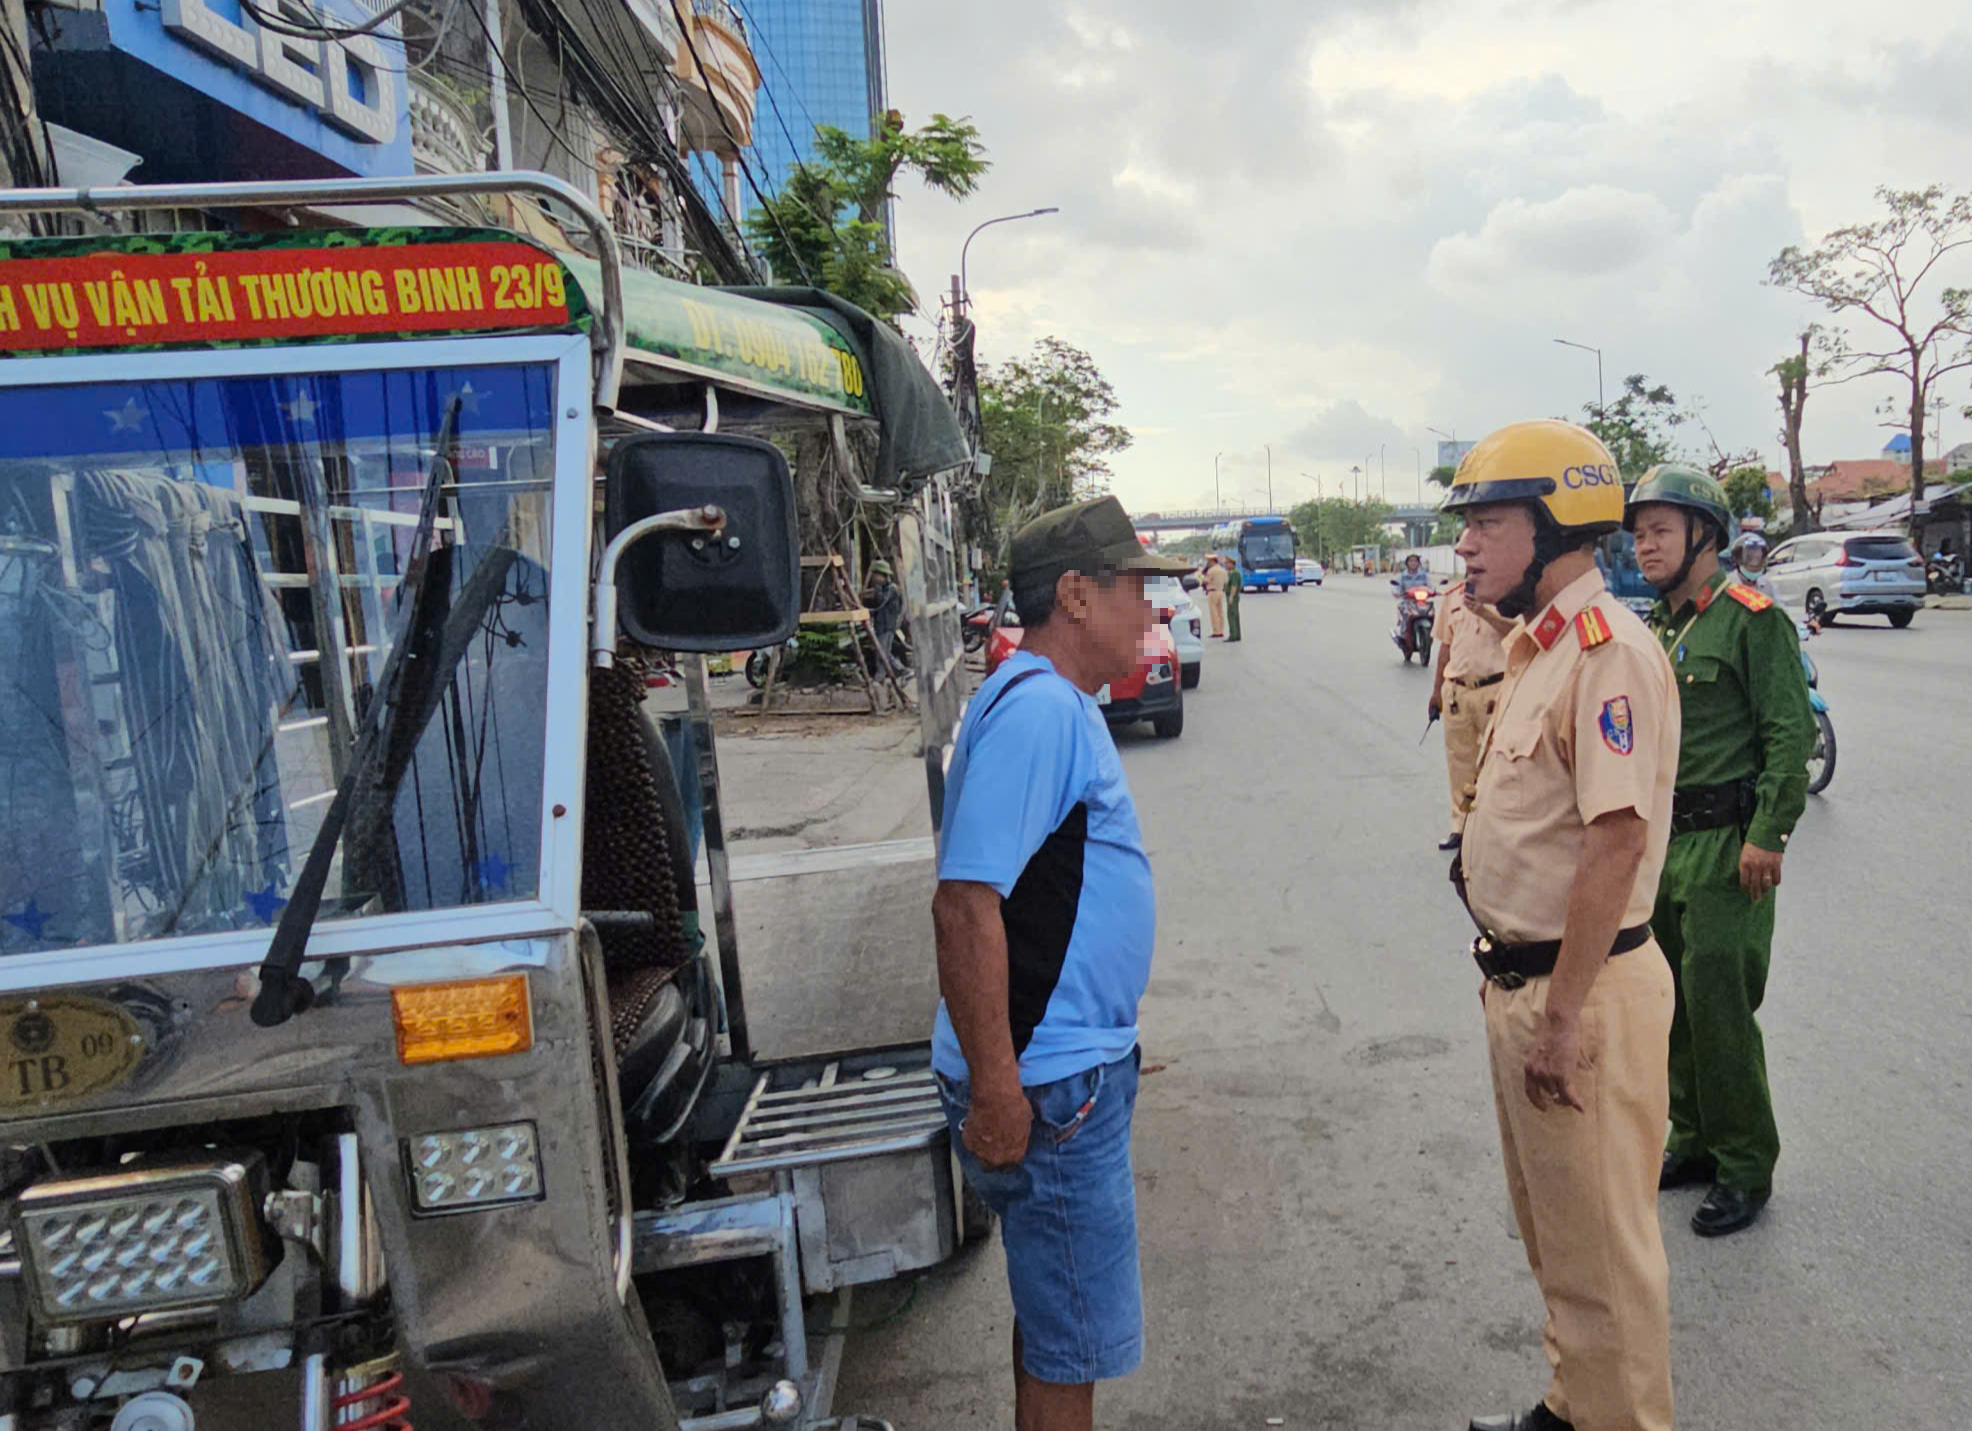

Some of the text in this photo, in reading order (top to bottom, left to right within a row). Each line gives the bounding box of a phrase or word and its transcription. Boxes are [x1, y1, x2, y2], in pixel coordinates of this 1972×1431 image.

[23, 283, 79, 338] VỤ
[83, 270, 169, 336] VẬN
[170, 261, 236, 323] TẢI
[239, 264, 388, 320] THƯƠNG
[394, 267, 483, 314] BINH
[490, 263, 566, 309] 23/9
[81, 1031, 114, 1058] 09
[8, 1054, 72, 1096] TB
